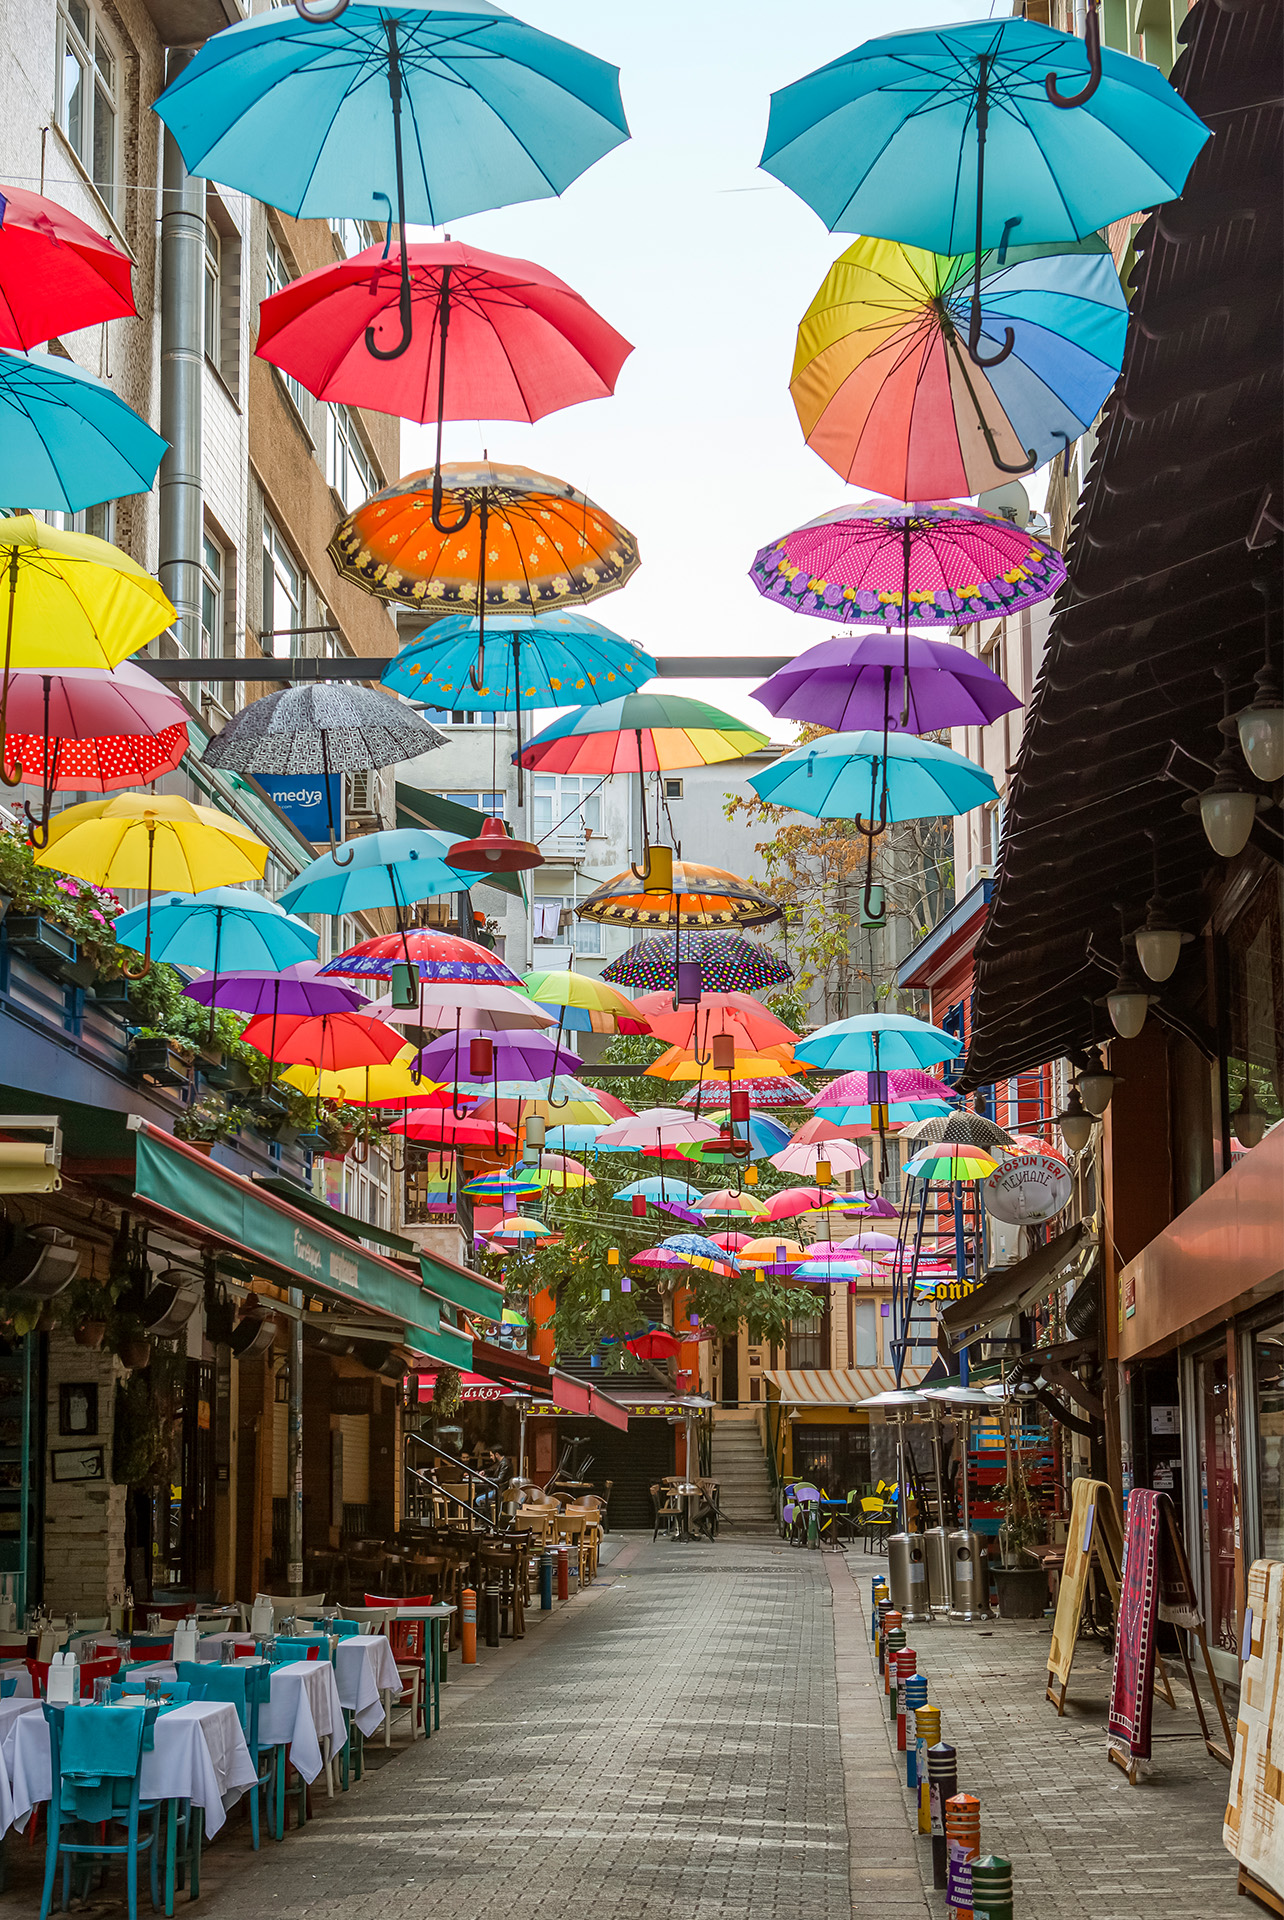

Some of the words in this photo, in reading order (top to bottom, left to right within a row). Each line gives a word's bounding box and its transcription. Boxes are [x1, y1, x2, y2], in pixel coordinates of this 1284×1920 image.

[267, 789, 322, 804] medya
[989, 1157, 1037, 1188] FATOŞ'UN
[1002, 1170, 1052, 1192] MEYHANE
[460, 1387, 500, 1399] dıköy
